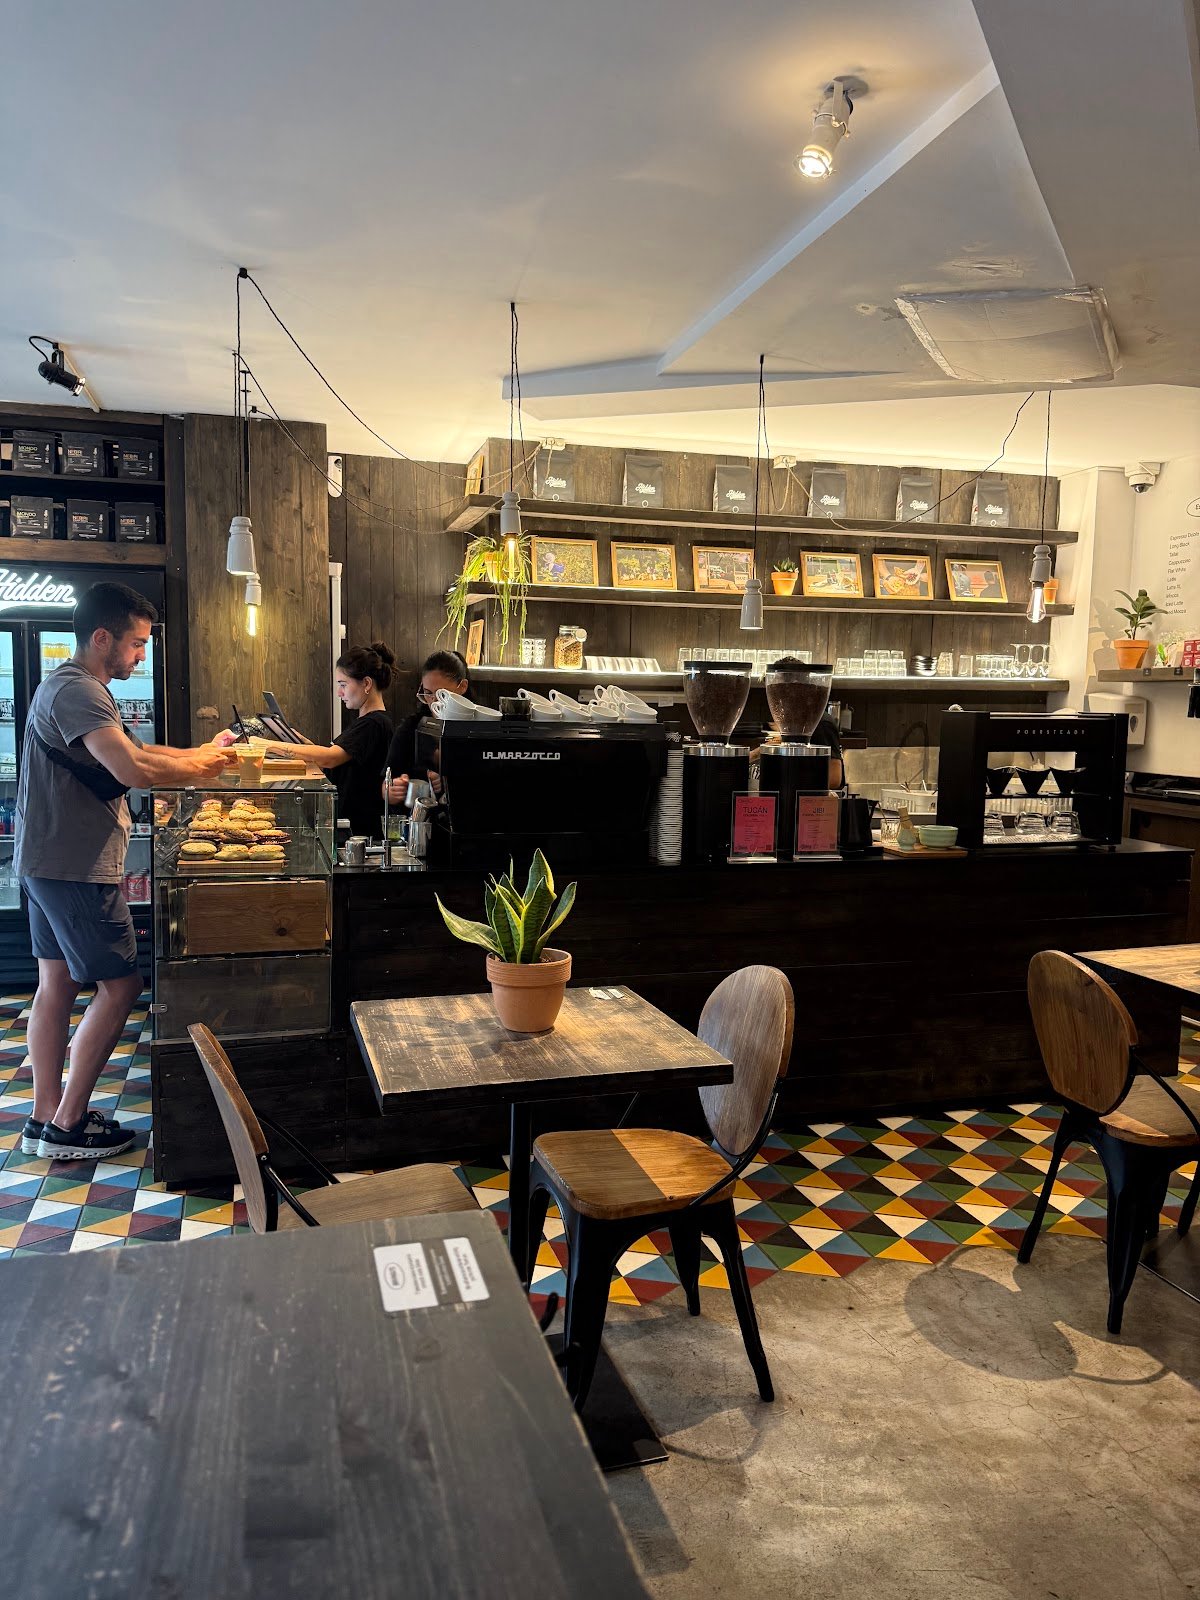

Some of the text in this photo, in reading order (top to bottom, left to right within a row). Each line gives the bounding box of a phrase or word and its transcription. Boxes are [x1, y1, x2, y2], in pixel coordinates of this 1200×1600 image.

[0, 568, 77, 605] Hidden
[482, 751, 561, 761] LA MARZOCCO
